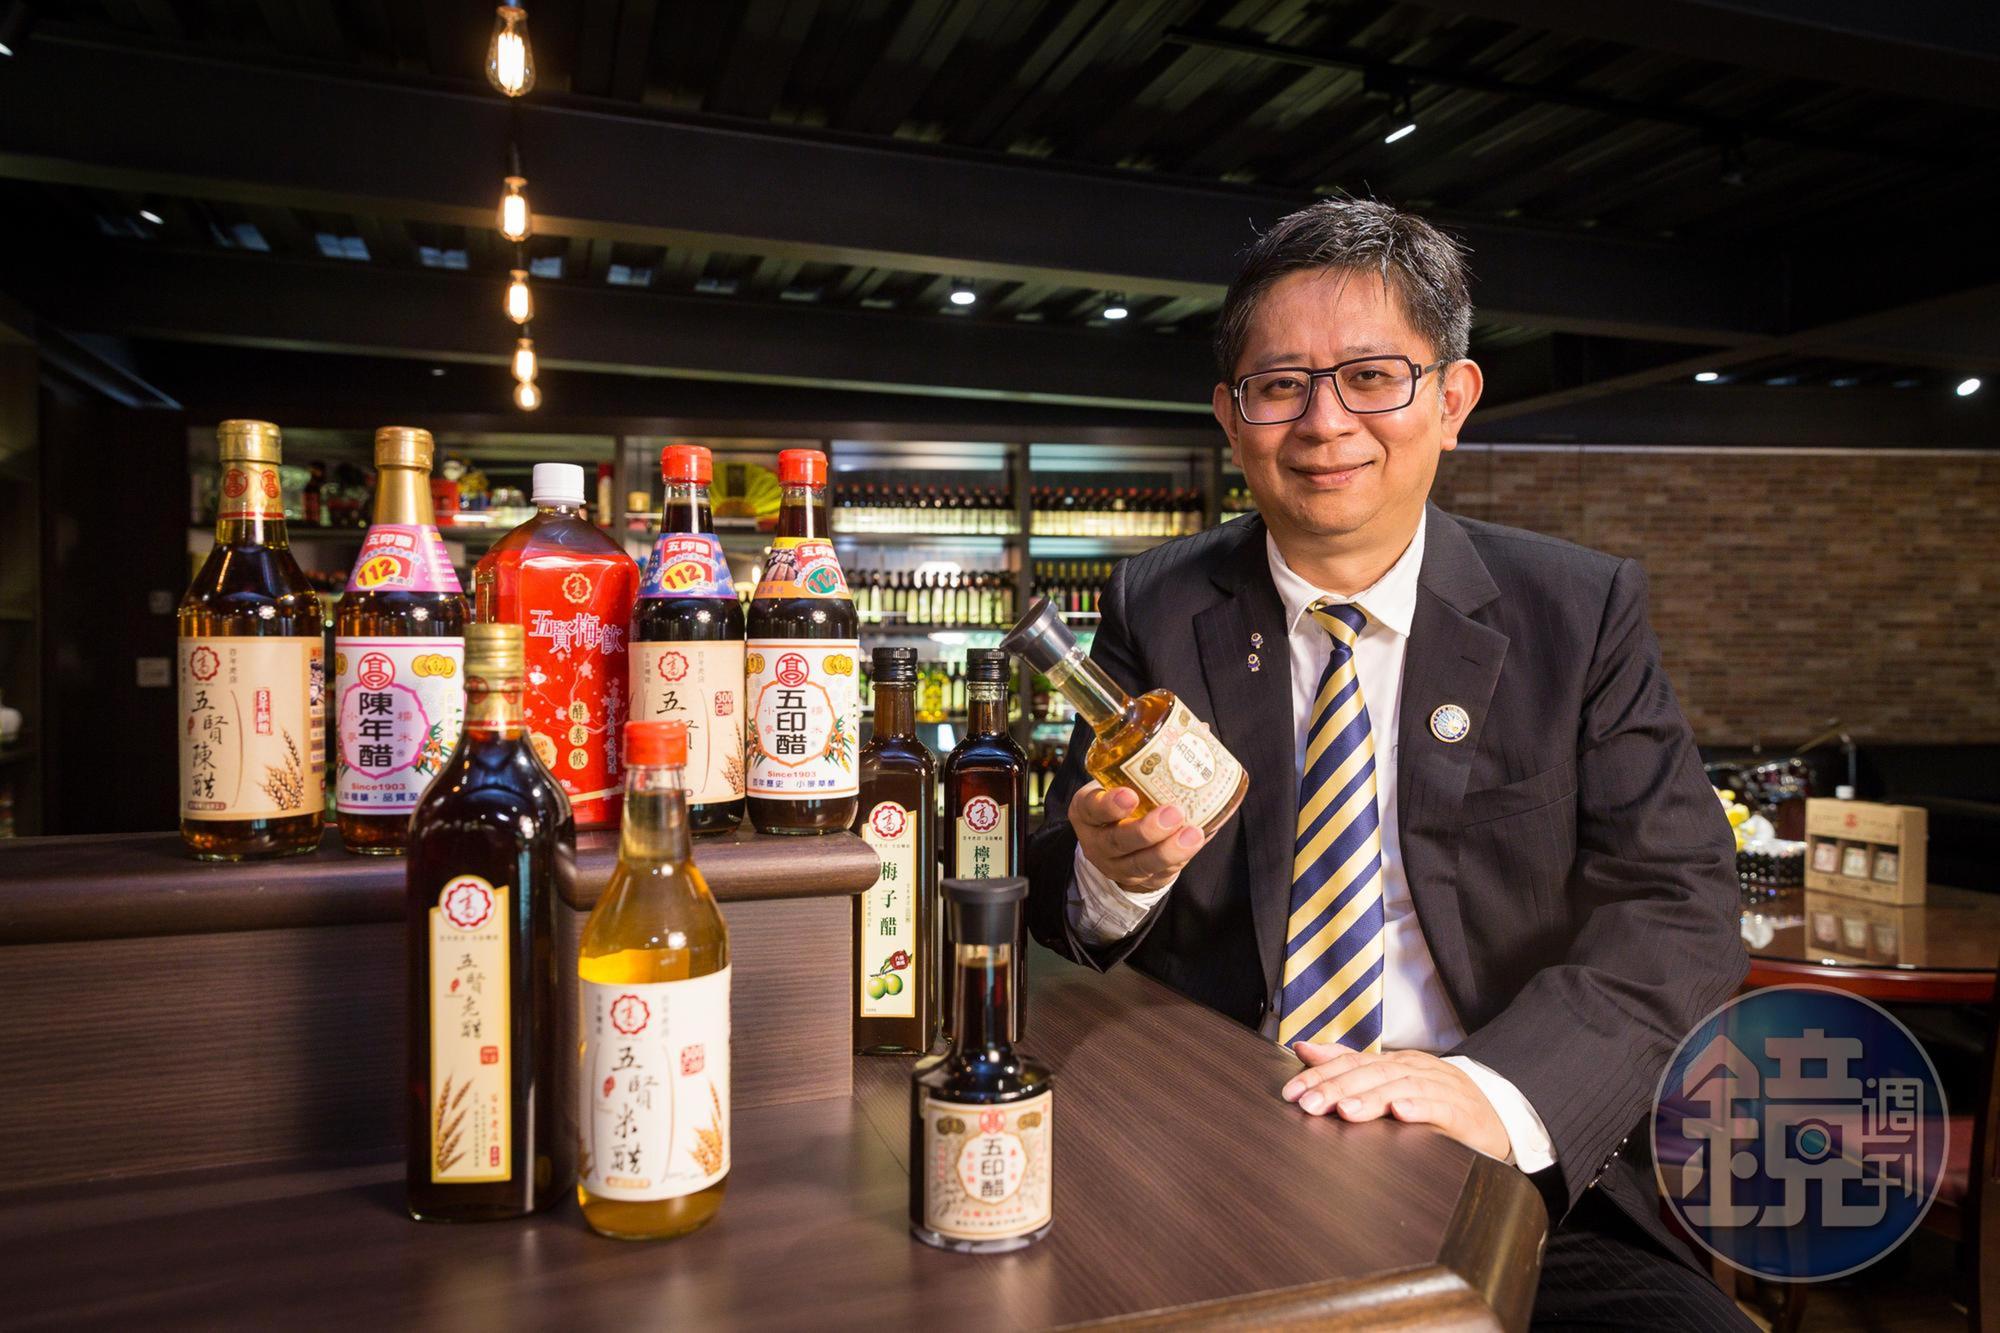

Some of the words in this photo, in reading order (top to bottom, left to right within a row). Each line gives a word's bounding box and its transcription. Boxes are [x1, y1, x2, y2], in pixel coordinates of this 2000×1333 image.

[358, 559, 395, 586] 112
[665, 565, 701, 589] 112
[809, 568, 837, 593] 112
[528, 609, 625, 656] 五賢梅飲
[716, 692, 733, 703] 300
[775, 689, 807, 755] 五印醋
[191, 690, 229, 800] 五賢陳醋
[358, 692, 394, 767] 陳年醋
[571, 704, 585, 767] 酵素飲
[351, 782, 407, 791] Since1903
[974, 845, 991, 880] 檸檬
[880, 861, 898, 937] 梅子醋
[611, 1047, 659, 1175] 五賢米醋
[981, 1138, 1004, 1197] 五印醋
